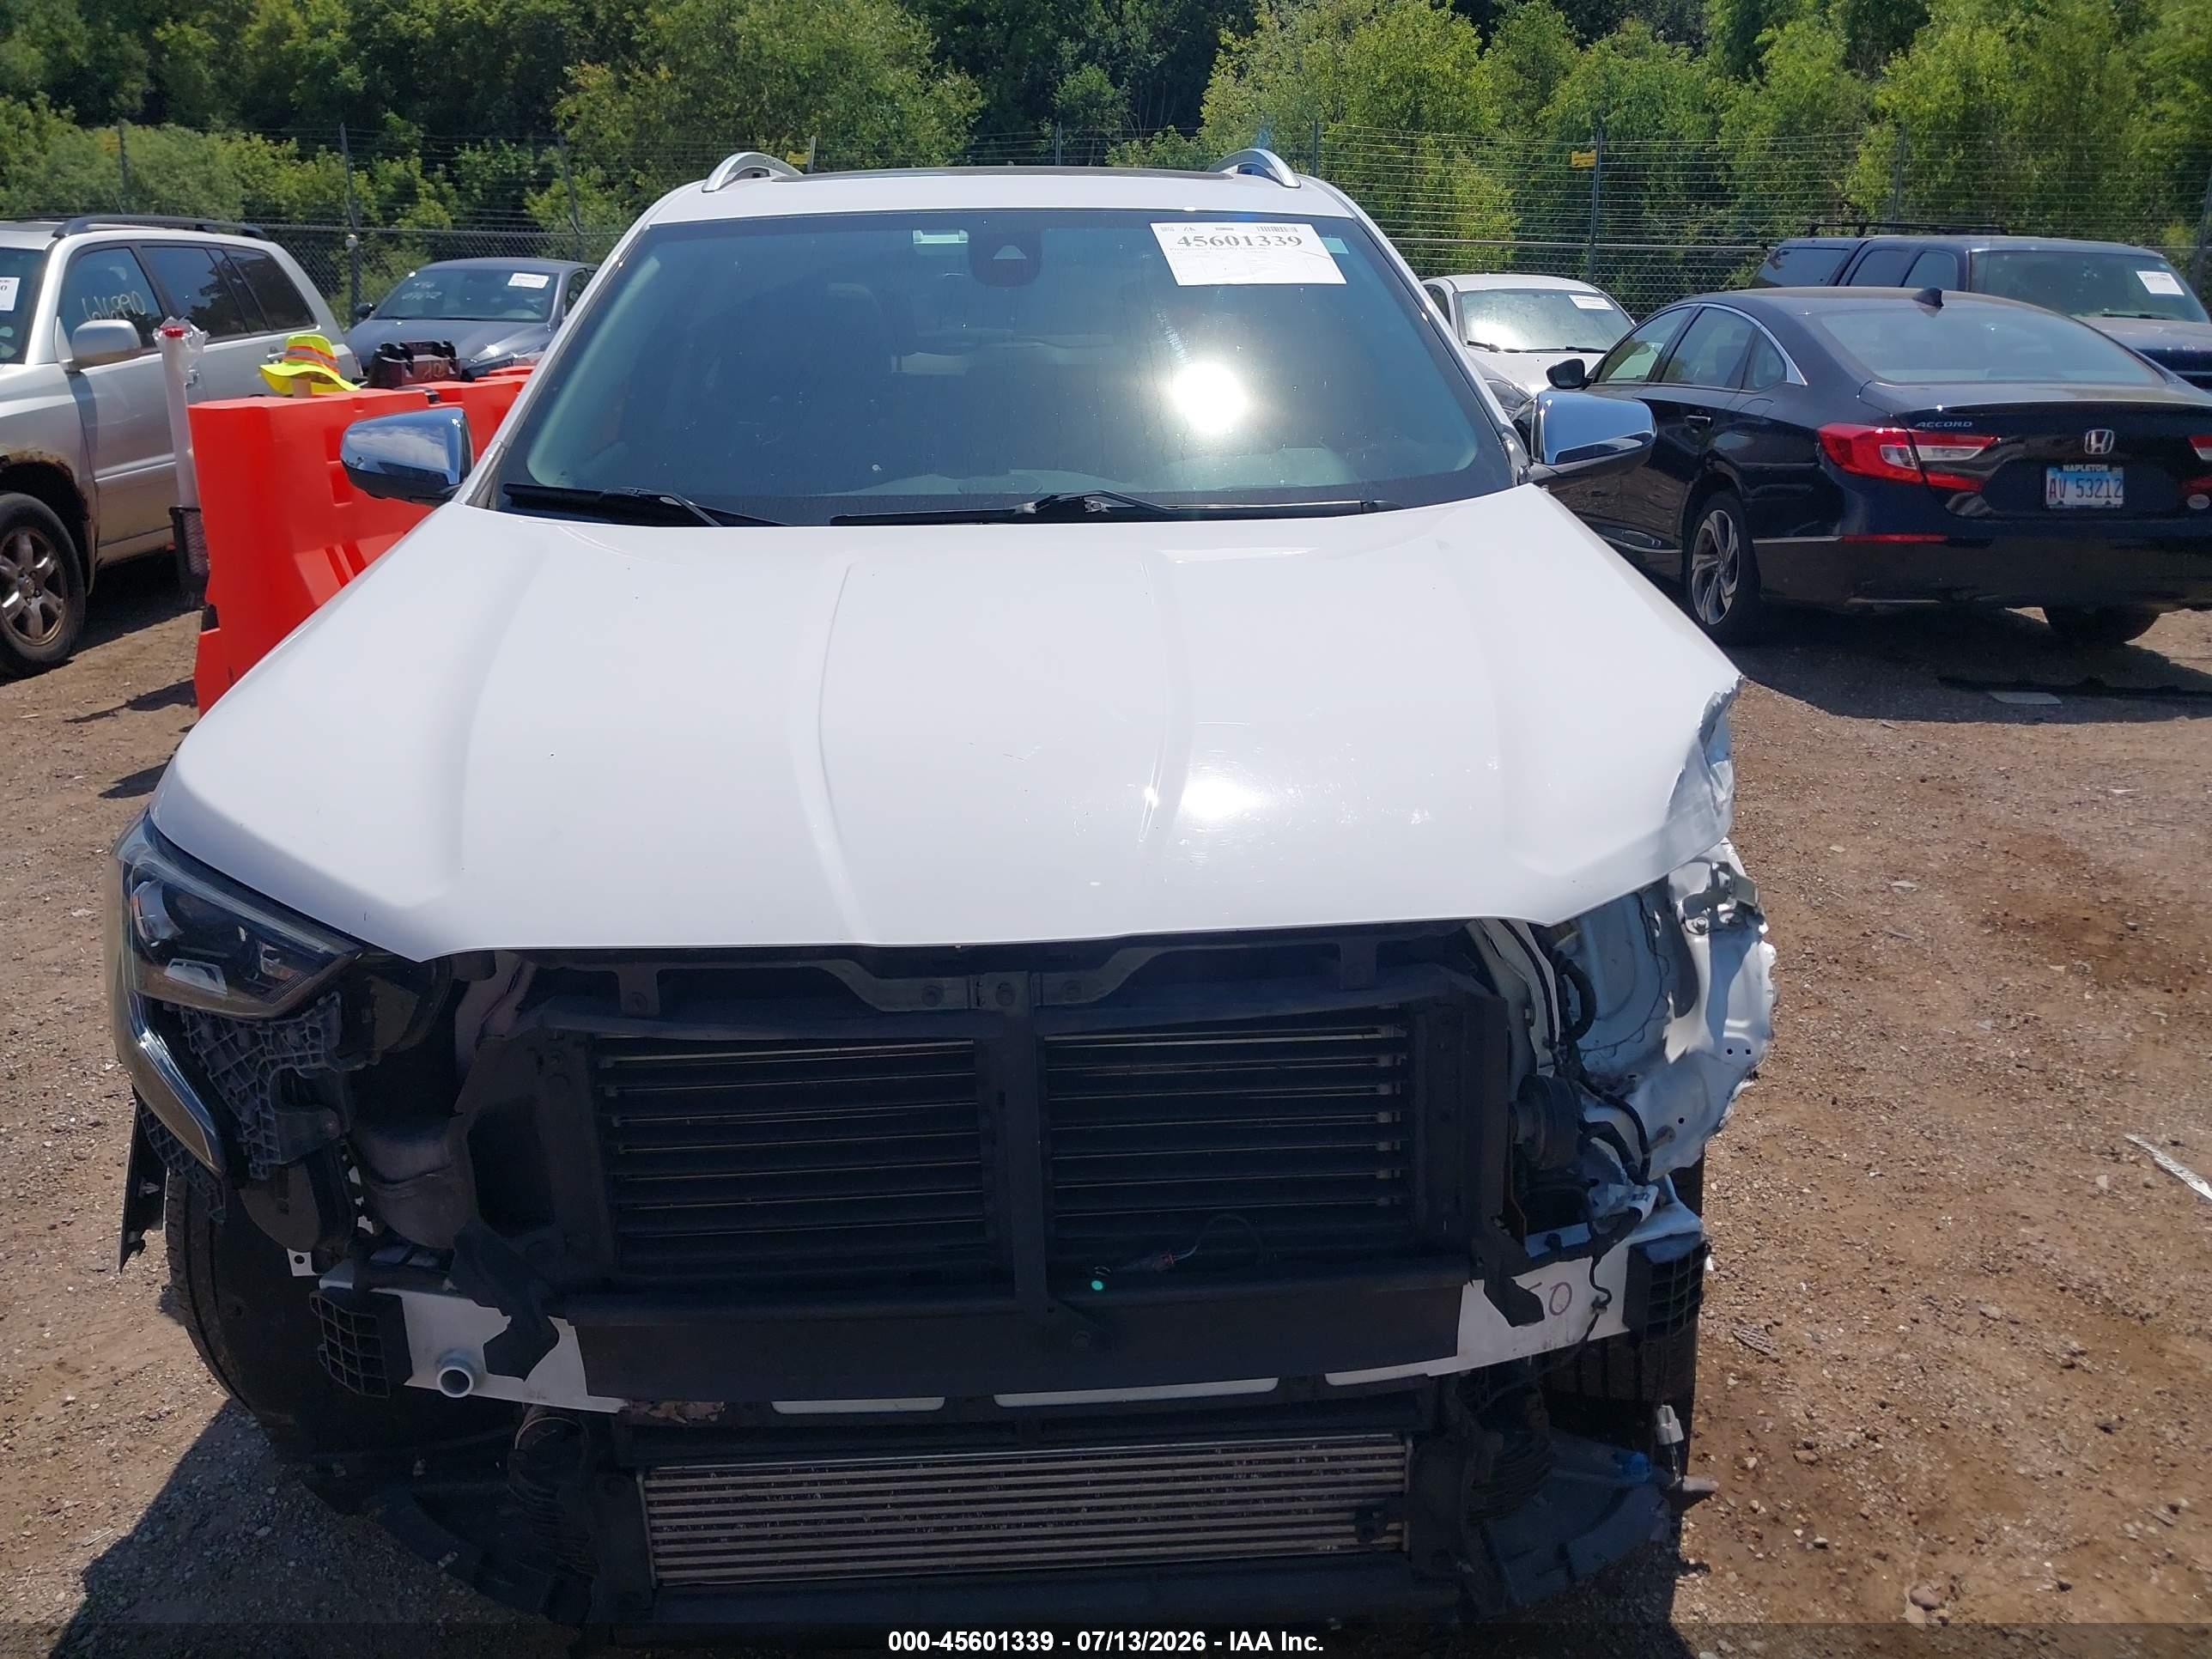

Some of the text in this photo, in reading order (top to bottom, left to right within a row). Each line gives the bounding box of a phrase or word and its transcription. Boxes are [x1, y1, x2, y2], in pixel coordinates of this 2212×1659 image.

[1176, 234, 1303, 247] 45601339
[2048, 477, 2123, 499] AV 53212
